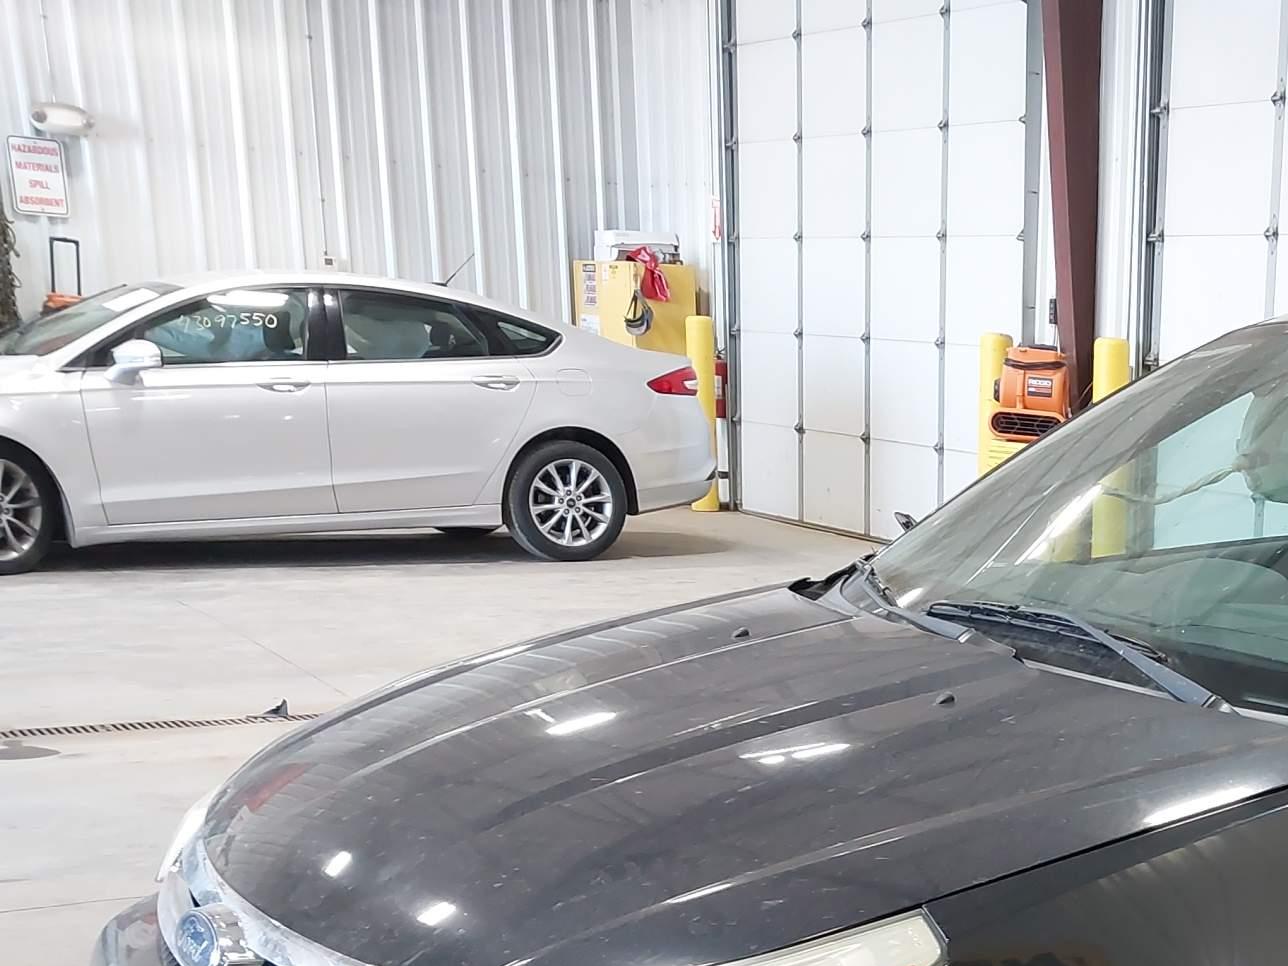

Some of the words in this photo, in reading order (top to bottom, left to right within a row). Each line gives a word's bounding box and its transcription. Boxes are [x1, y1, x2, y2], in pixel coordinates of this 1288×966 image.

[11, 144, 59, 157] HAZARDOUS
[15, 161, 60, 173] MATERIALS
[29, 179, 50, 190] SPILL
[19, 195, 64, 207] ABSORBENT
